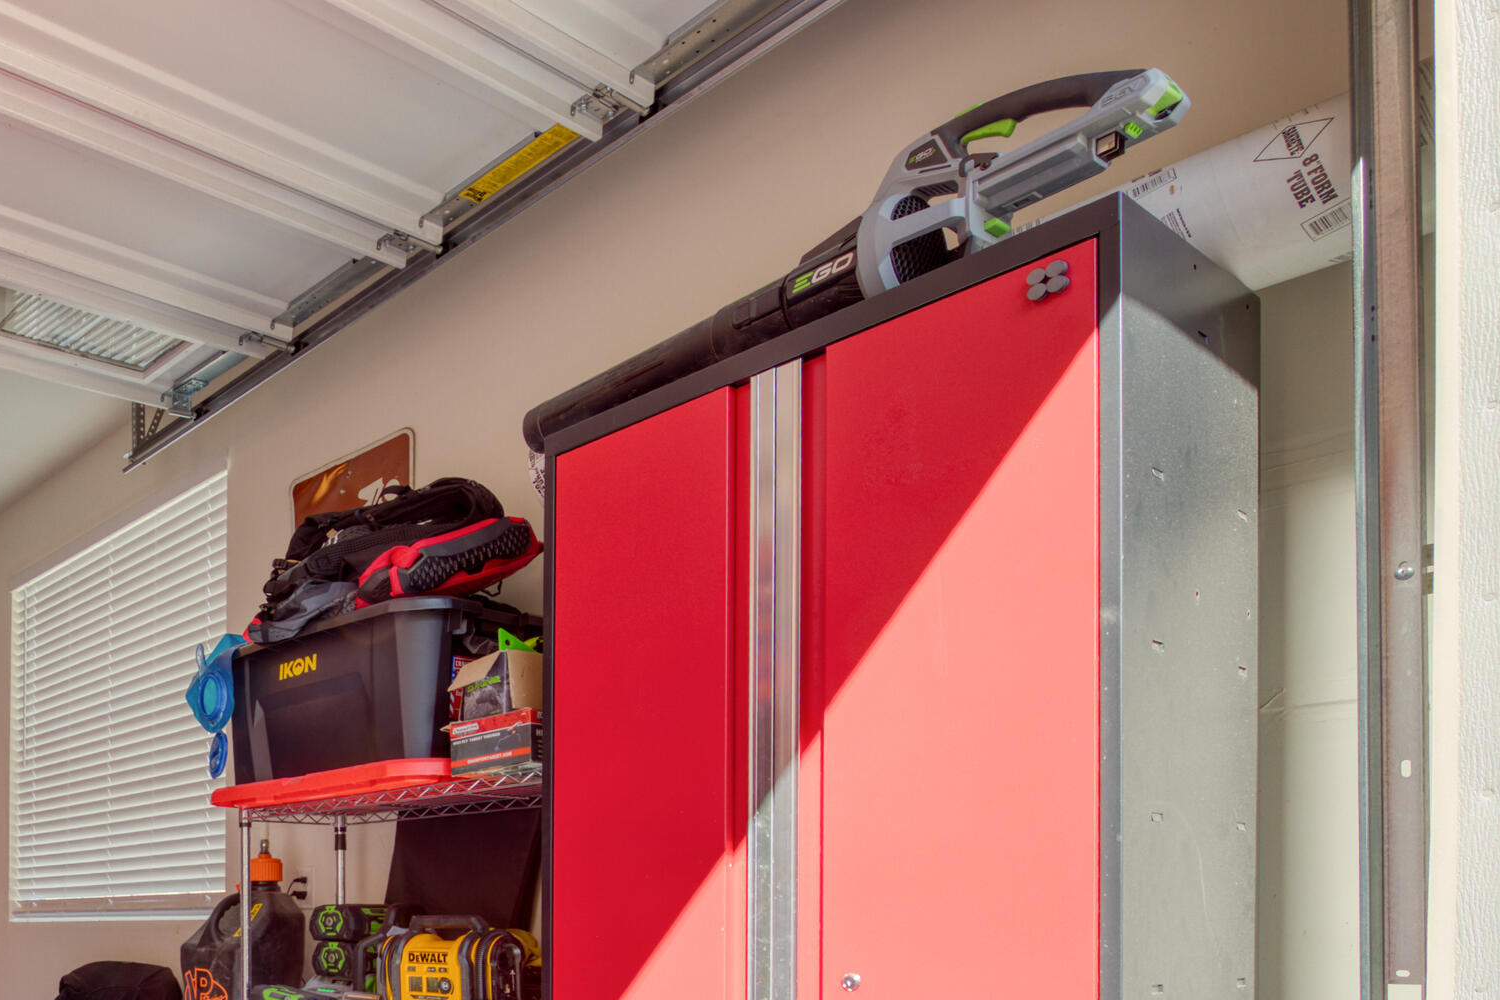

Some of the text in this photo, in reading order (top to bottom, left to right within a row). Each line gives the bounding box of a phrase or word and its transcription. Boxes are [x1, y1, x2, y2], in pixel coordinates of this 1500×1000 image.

[908, 147, 934, 163] EGO
[1287, 170, 1316, 209] TUBE
[1307, 165, 1338, 204] FORM
[792, 253, 854, 294] EGO
[279, 653, 317, 681] IKON
